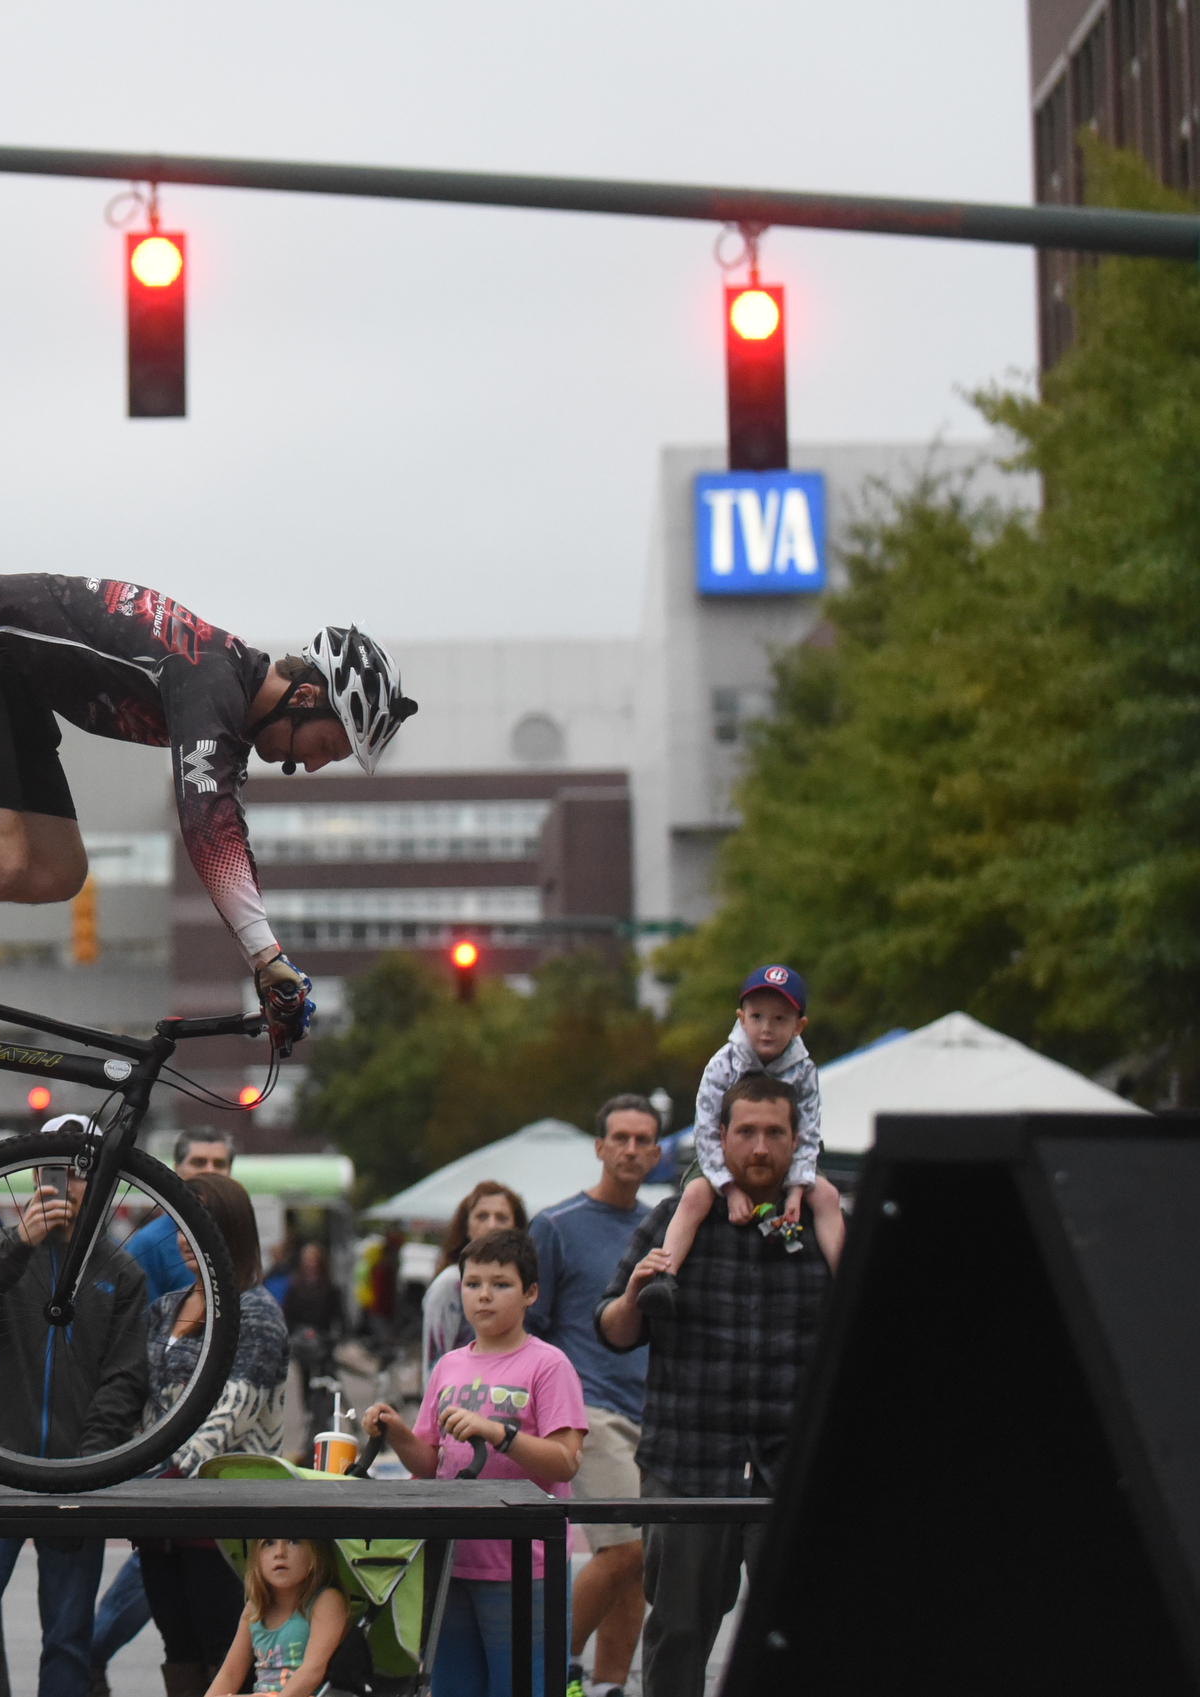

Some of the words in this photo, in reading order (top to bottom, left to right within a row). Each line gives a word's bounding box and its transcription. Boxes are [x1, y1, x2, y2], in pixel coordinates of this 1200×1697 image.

[703, 487, 818, 575] TVA
[152, 604, 165, 639] SHOWS
[204, 1252, 222, 1319] KENDA
